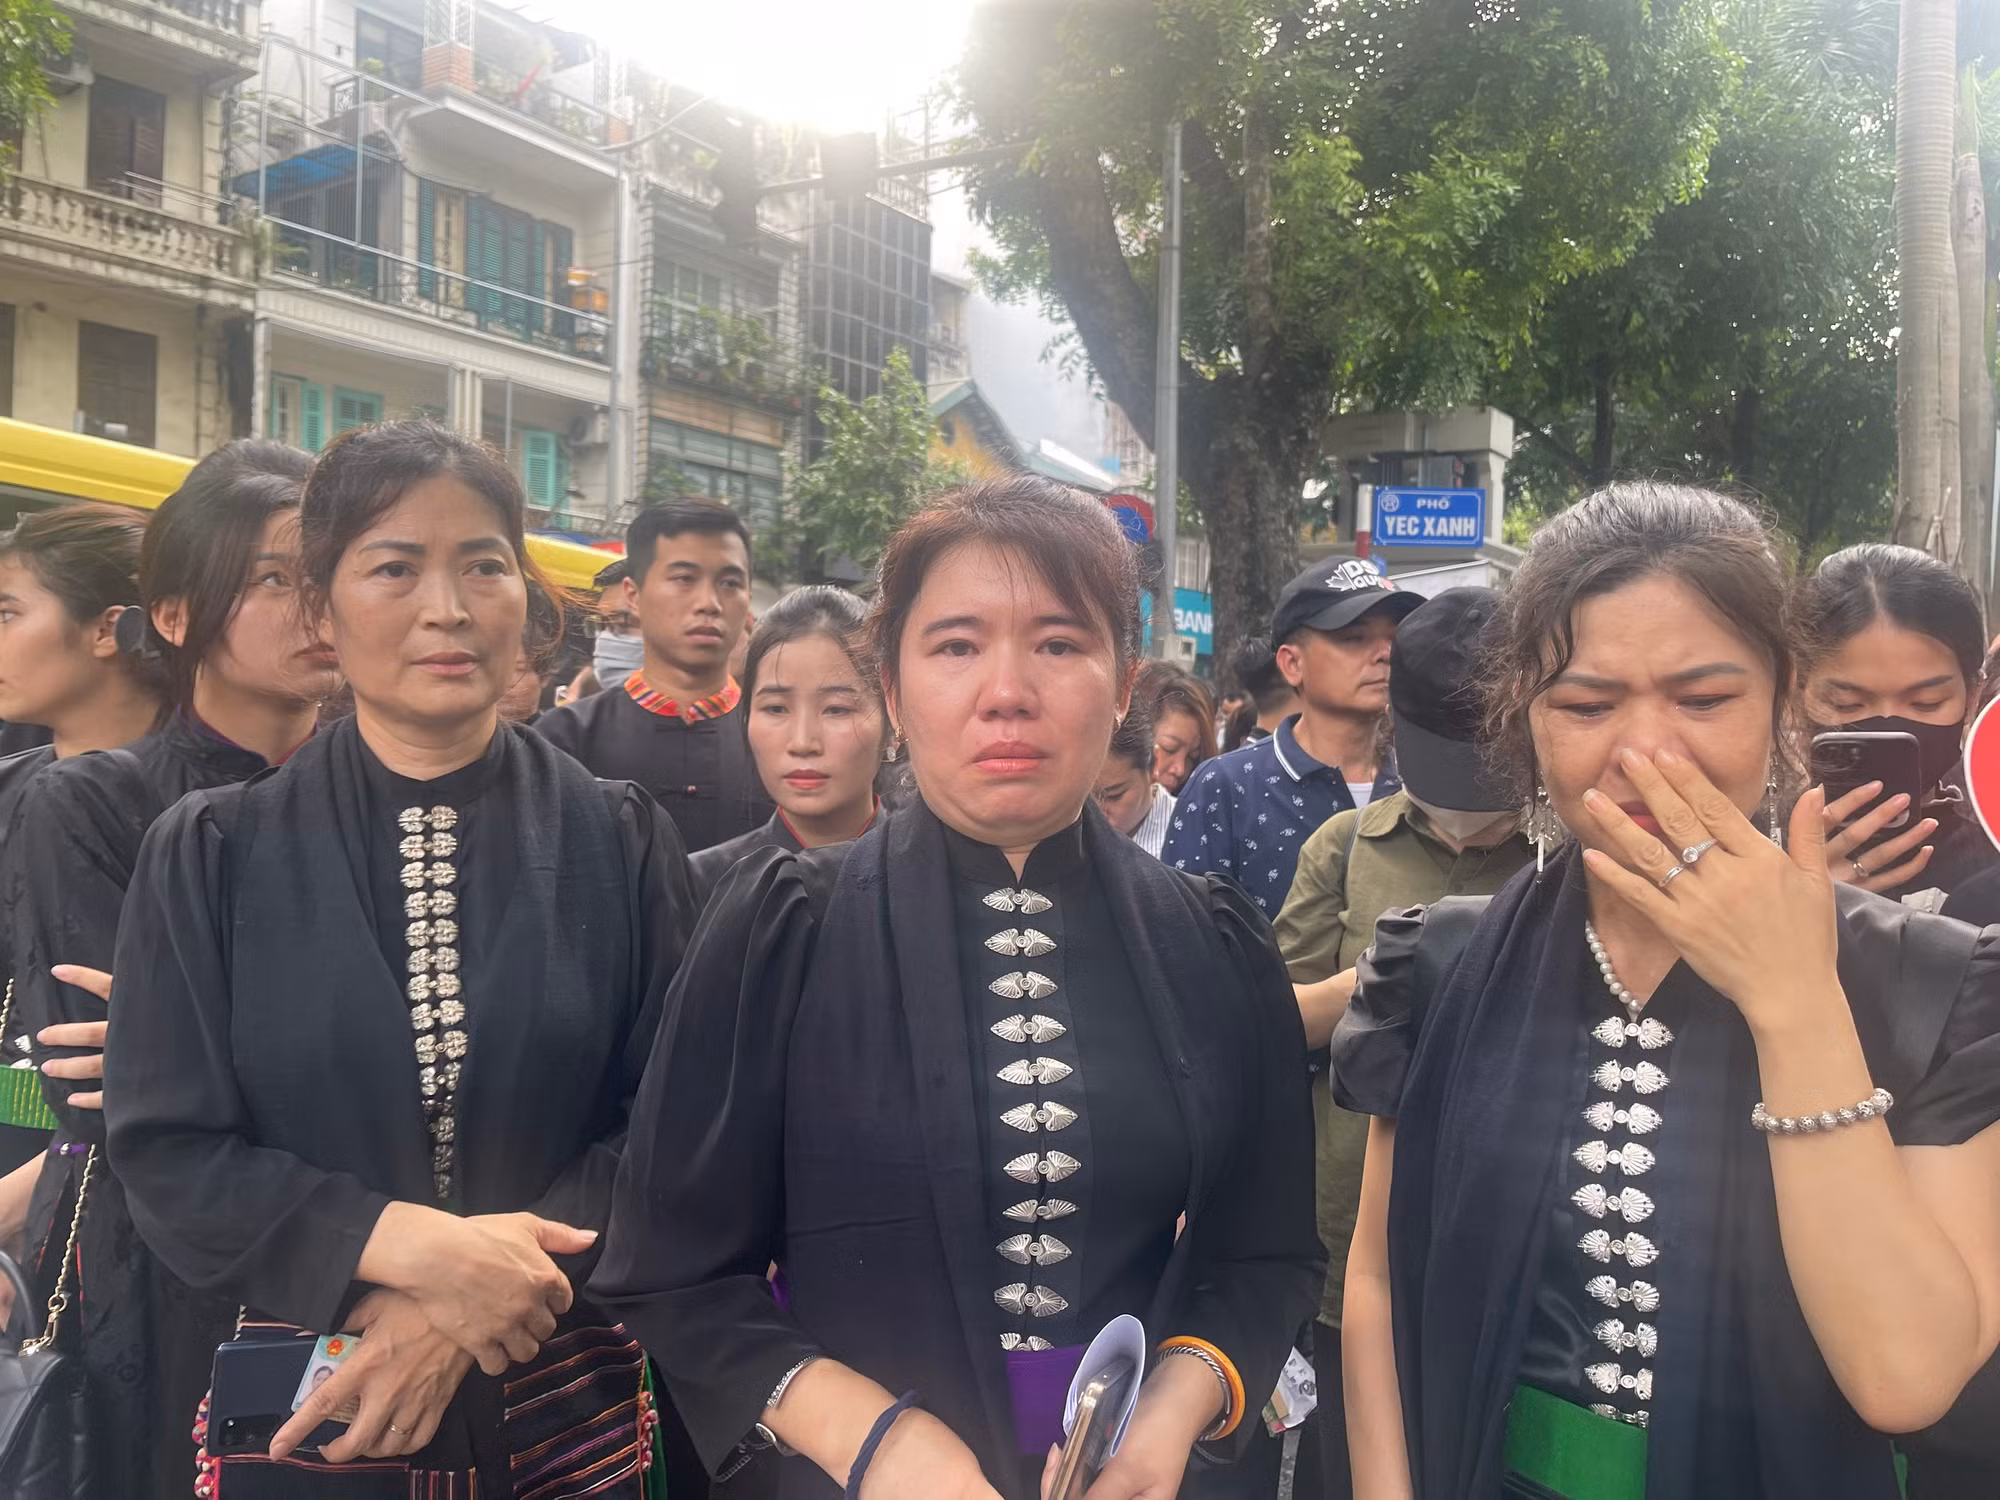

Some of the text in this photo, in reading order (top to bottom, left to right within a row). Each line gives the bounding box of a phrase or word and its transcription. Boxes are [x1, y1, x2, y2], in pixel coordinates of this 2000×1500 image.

[1416, 495, 1450, 510] PHỐ
[1384, 515, 1476, 537] YEC XANH
